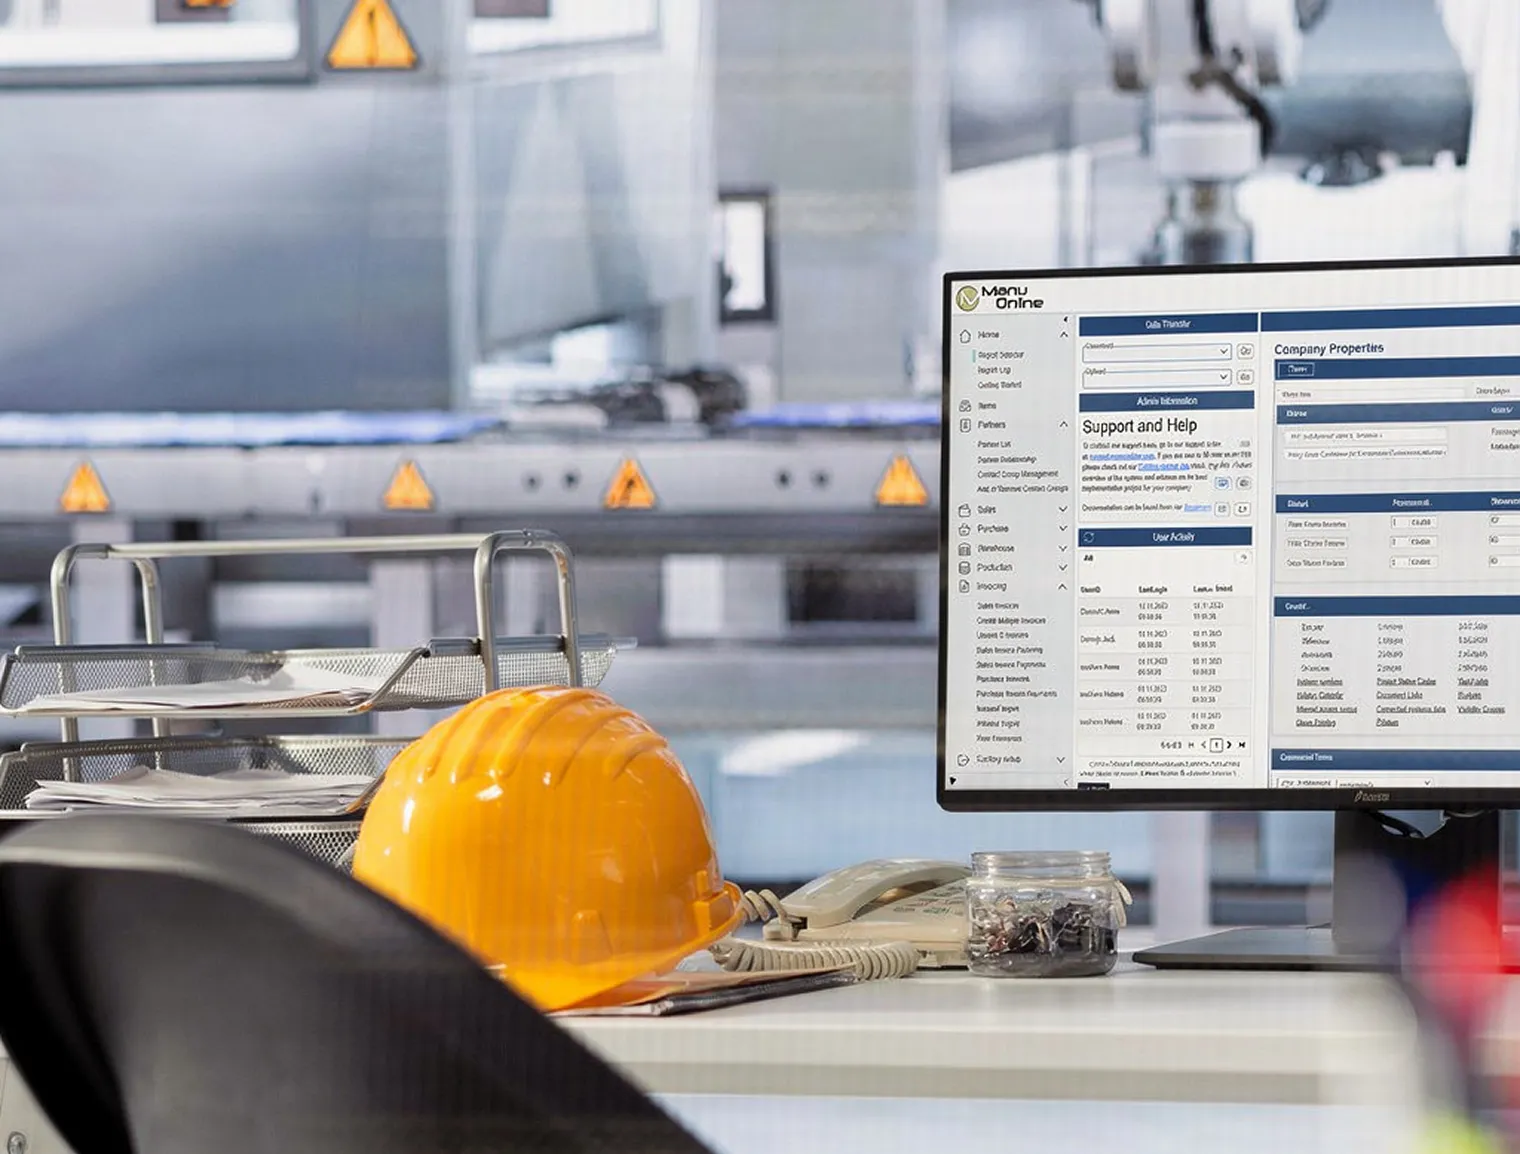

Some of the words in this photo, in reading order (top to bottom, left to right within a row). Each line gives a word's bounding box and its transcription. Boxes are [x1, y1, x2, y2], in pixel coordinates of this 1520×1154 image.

[981, 285, 1028, 296] Manu
[1274, 343, 1327, 356] Company
[1082, 419, 1134, 437] Support
[1137, 418, 1163, 432] and
[1167, 418, 1198, 435] Help
